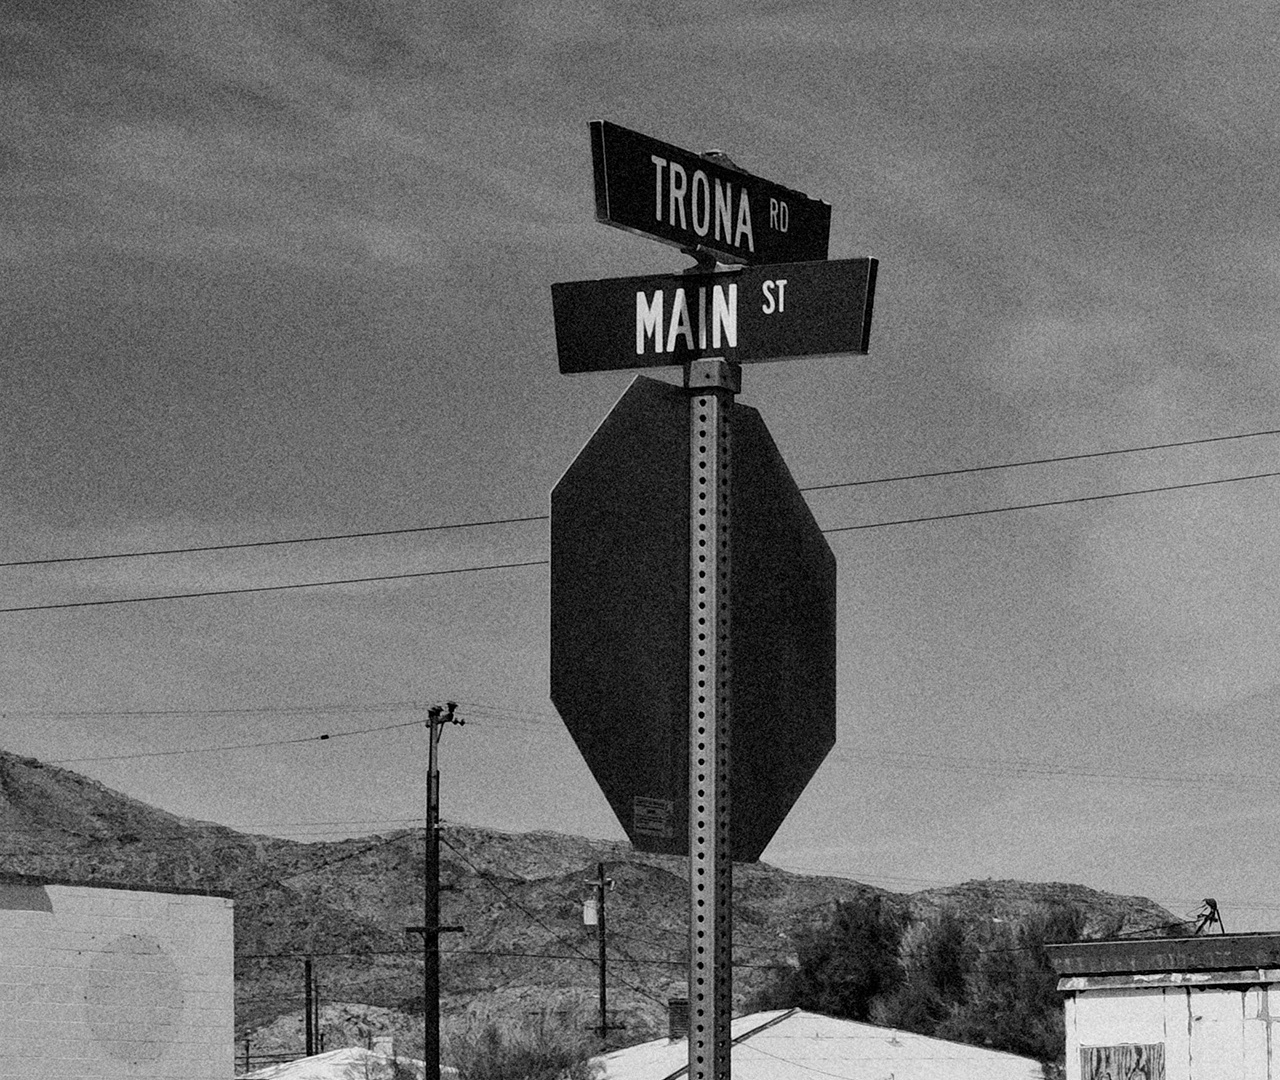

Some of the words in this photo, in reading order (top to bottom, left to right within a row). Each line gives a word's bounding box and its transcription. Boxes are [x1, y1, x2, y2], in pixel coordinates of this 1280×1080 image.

[651, 154, 754, 252] TRONA
[769, 197, 789, 232] RD
[636, 283, 737, 354] MAIN
[761, 279, 787, 314] ST
